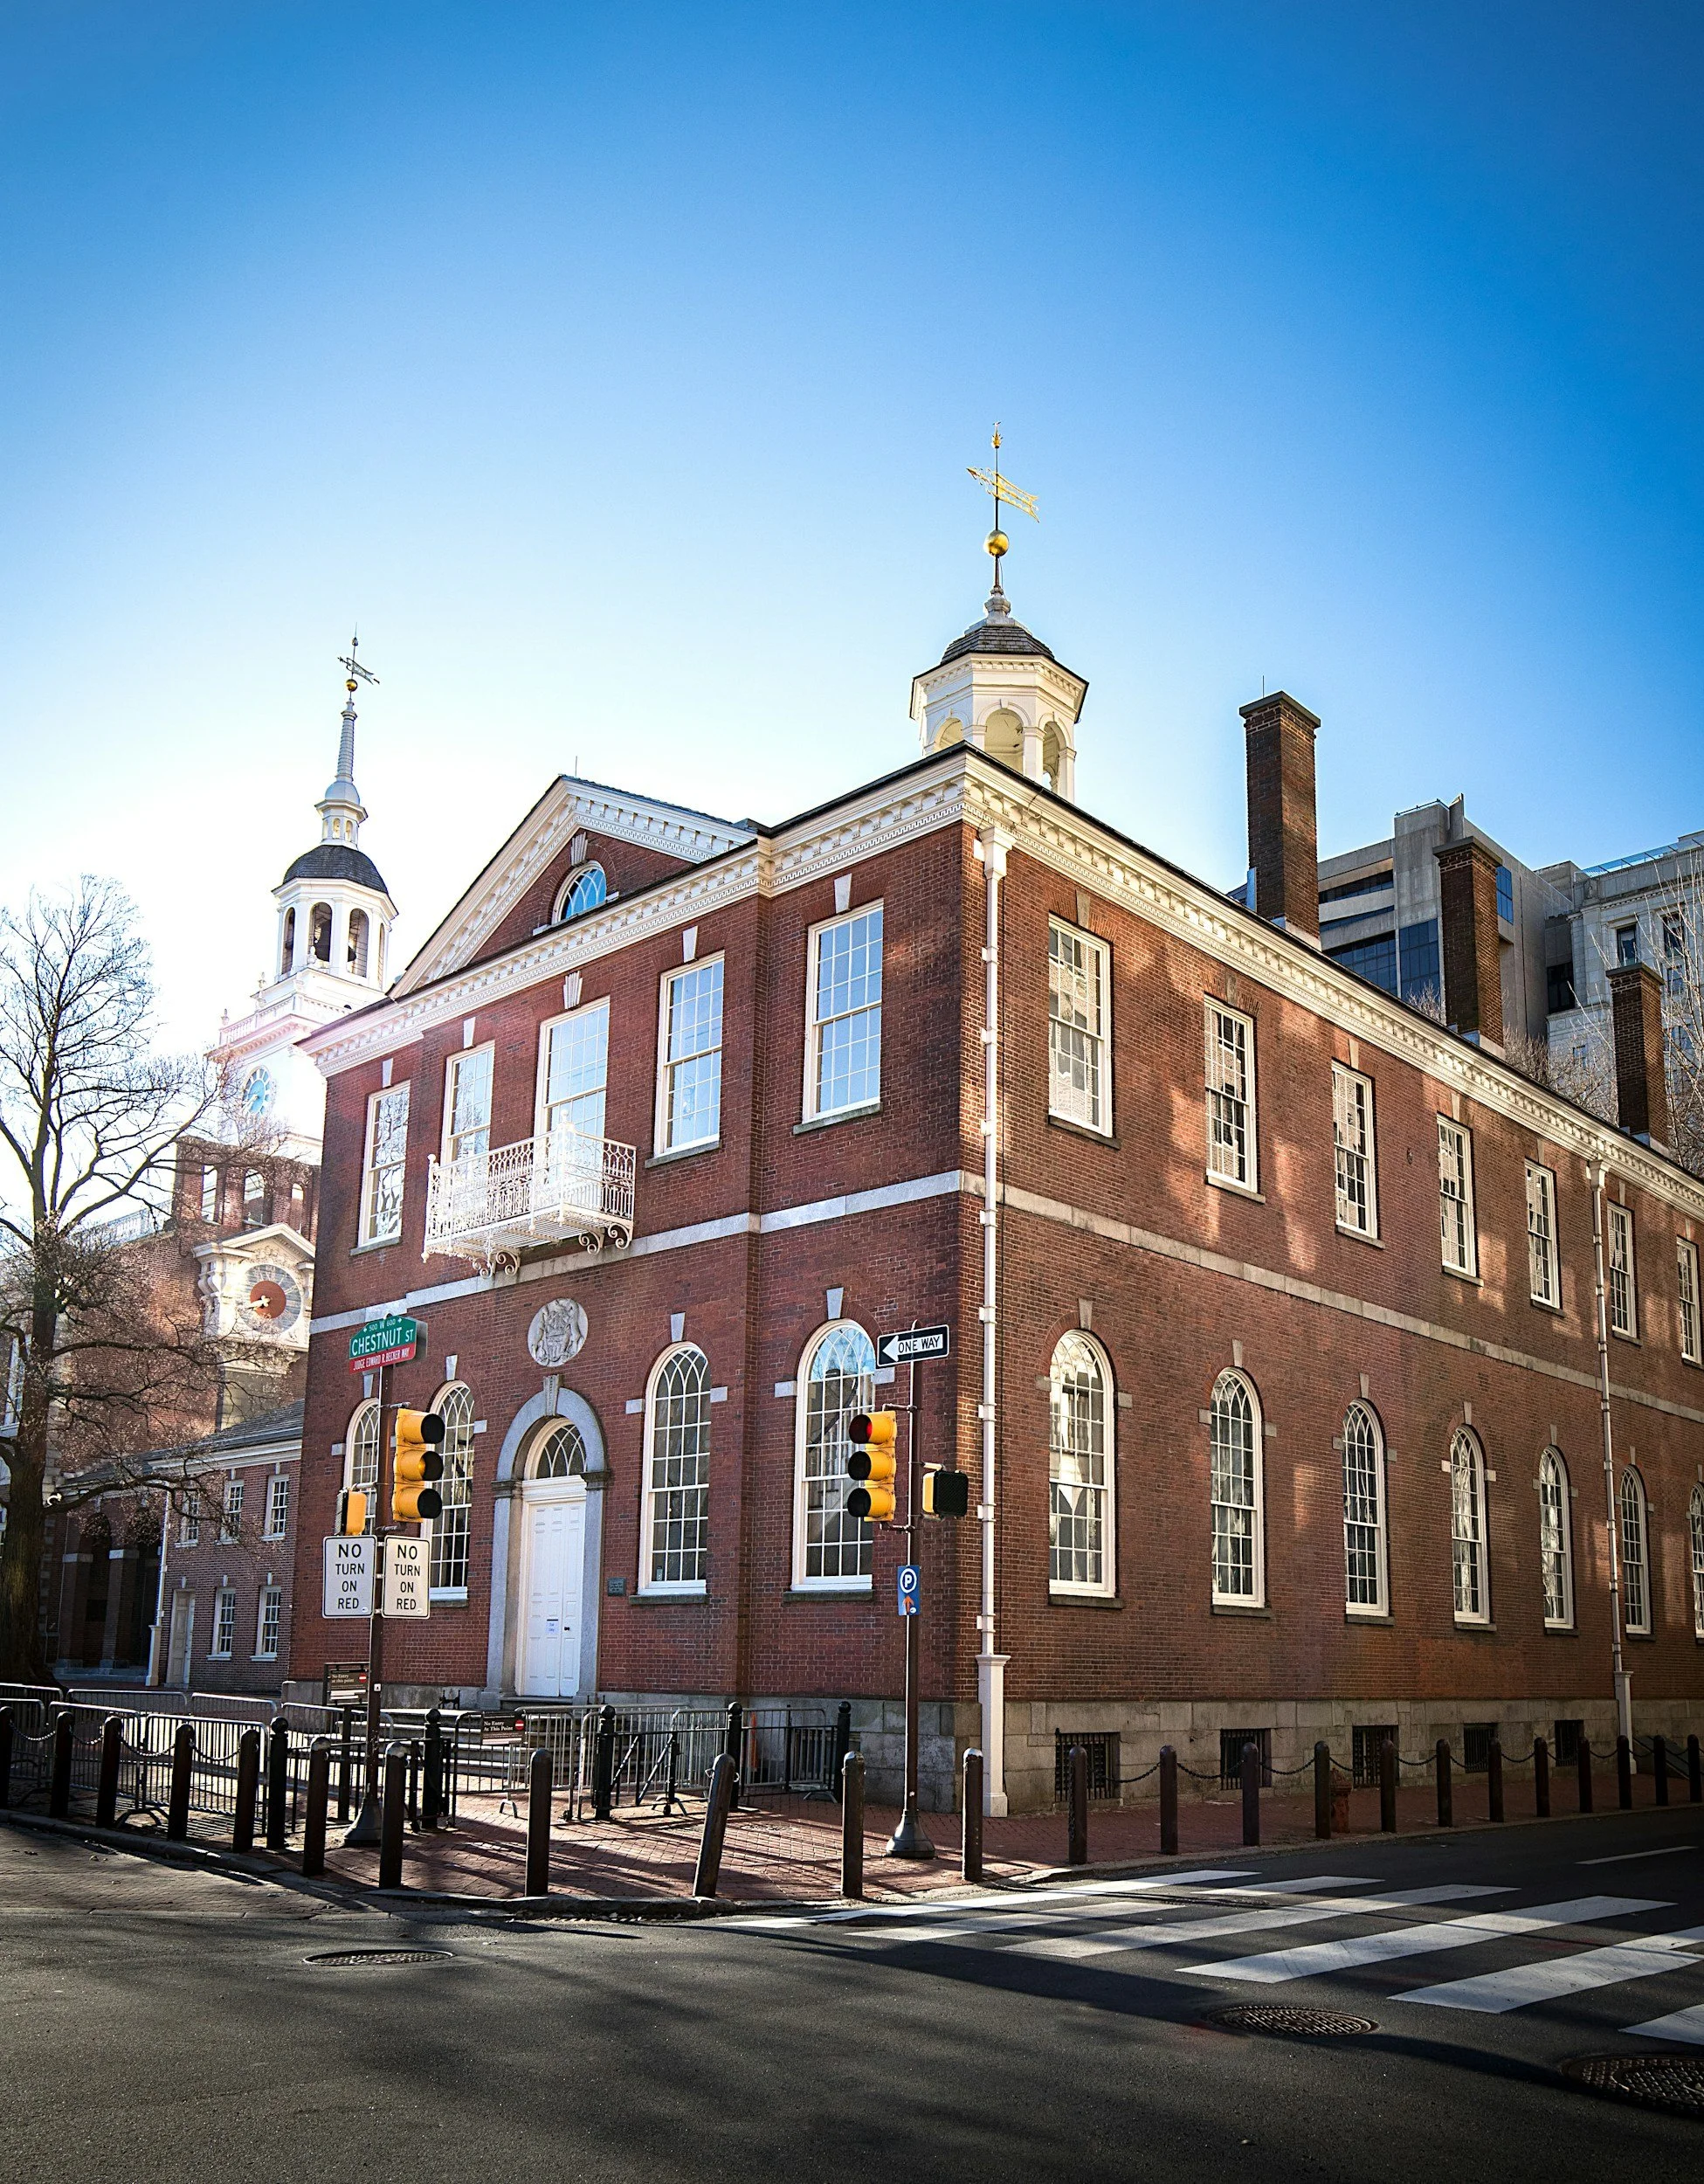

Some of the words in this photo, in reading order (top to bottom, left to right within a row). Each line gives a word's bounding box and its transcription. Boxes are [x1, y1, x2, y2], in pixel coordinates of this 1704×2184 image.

[379, 1320, 385, 1329] W
[351, 1327, 403, 1356] CHESTNUT
[405, 1329, 414, 1342] ST
[898, 1339, 918, 1353] ONE
[921, 1336, 941, 1350] WAY
[353, 1358, 365, 1371] JUDGE
[366, 1354, 381, 1367] EDWARD
[385, 1350, 401, 1362] BECKER
[402, 1347, 410, 1358] WAY
[338, 1544, 362, 1558] NO
[397, 1545, 417, 1559] NO
[335, 1563, 365, 1575] TURN
[394, 1564, 421, 1576] TURN
[341, 1580, 357, 1592] ON
[400, 1581, 414, 1593] ON
[904, 1574, 913, 1588] P
[337, 1598, 360, 1609] RED
[397, 1598, 417, 1610] RED
